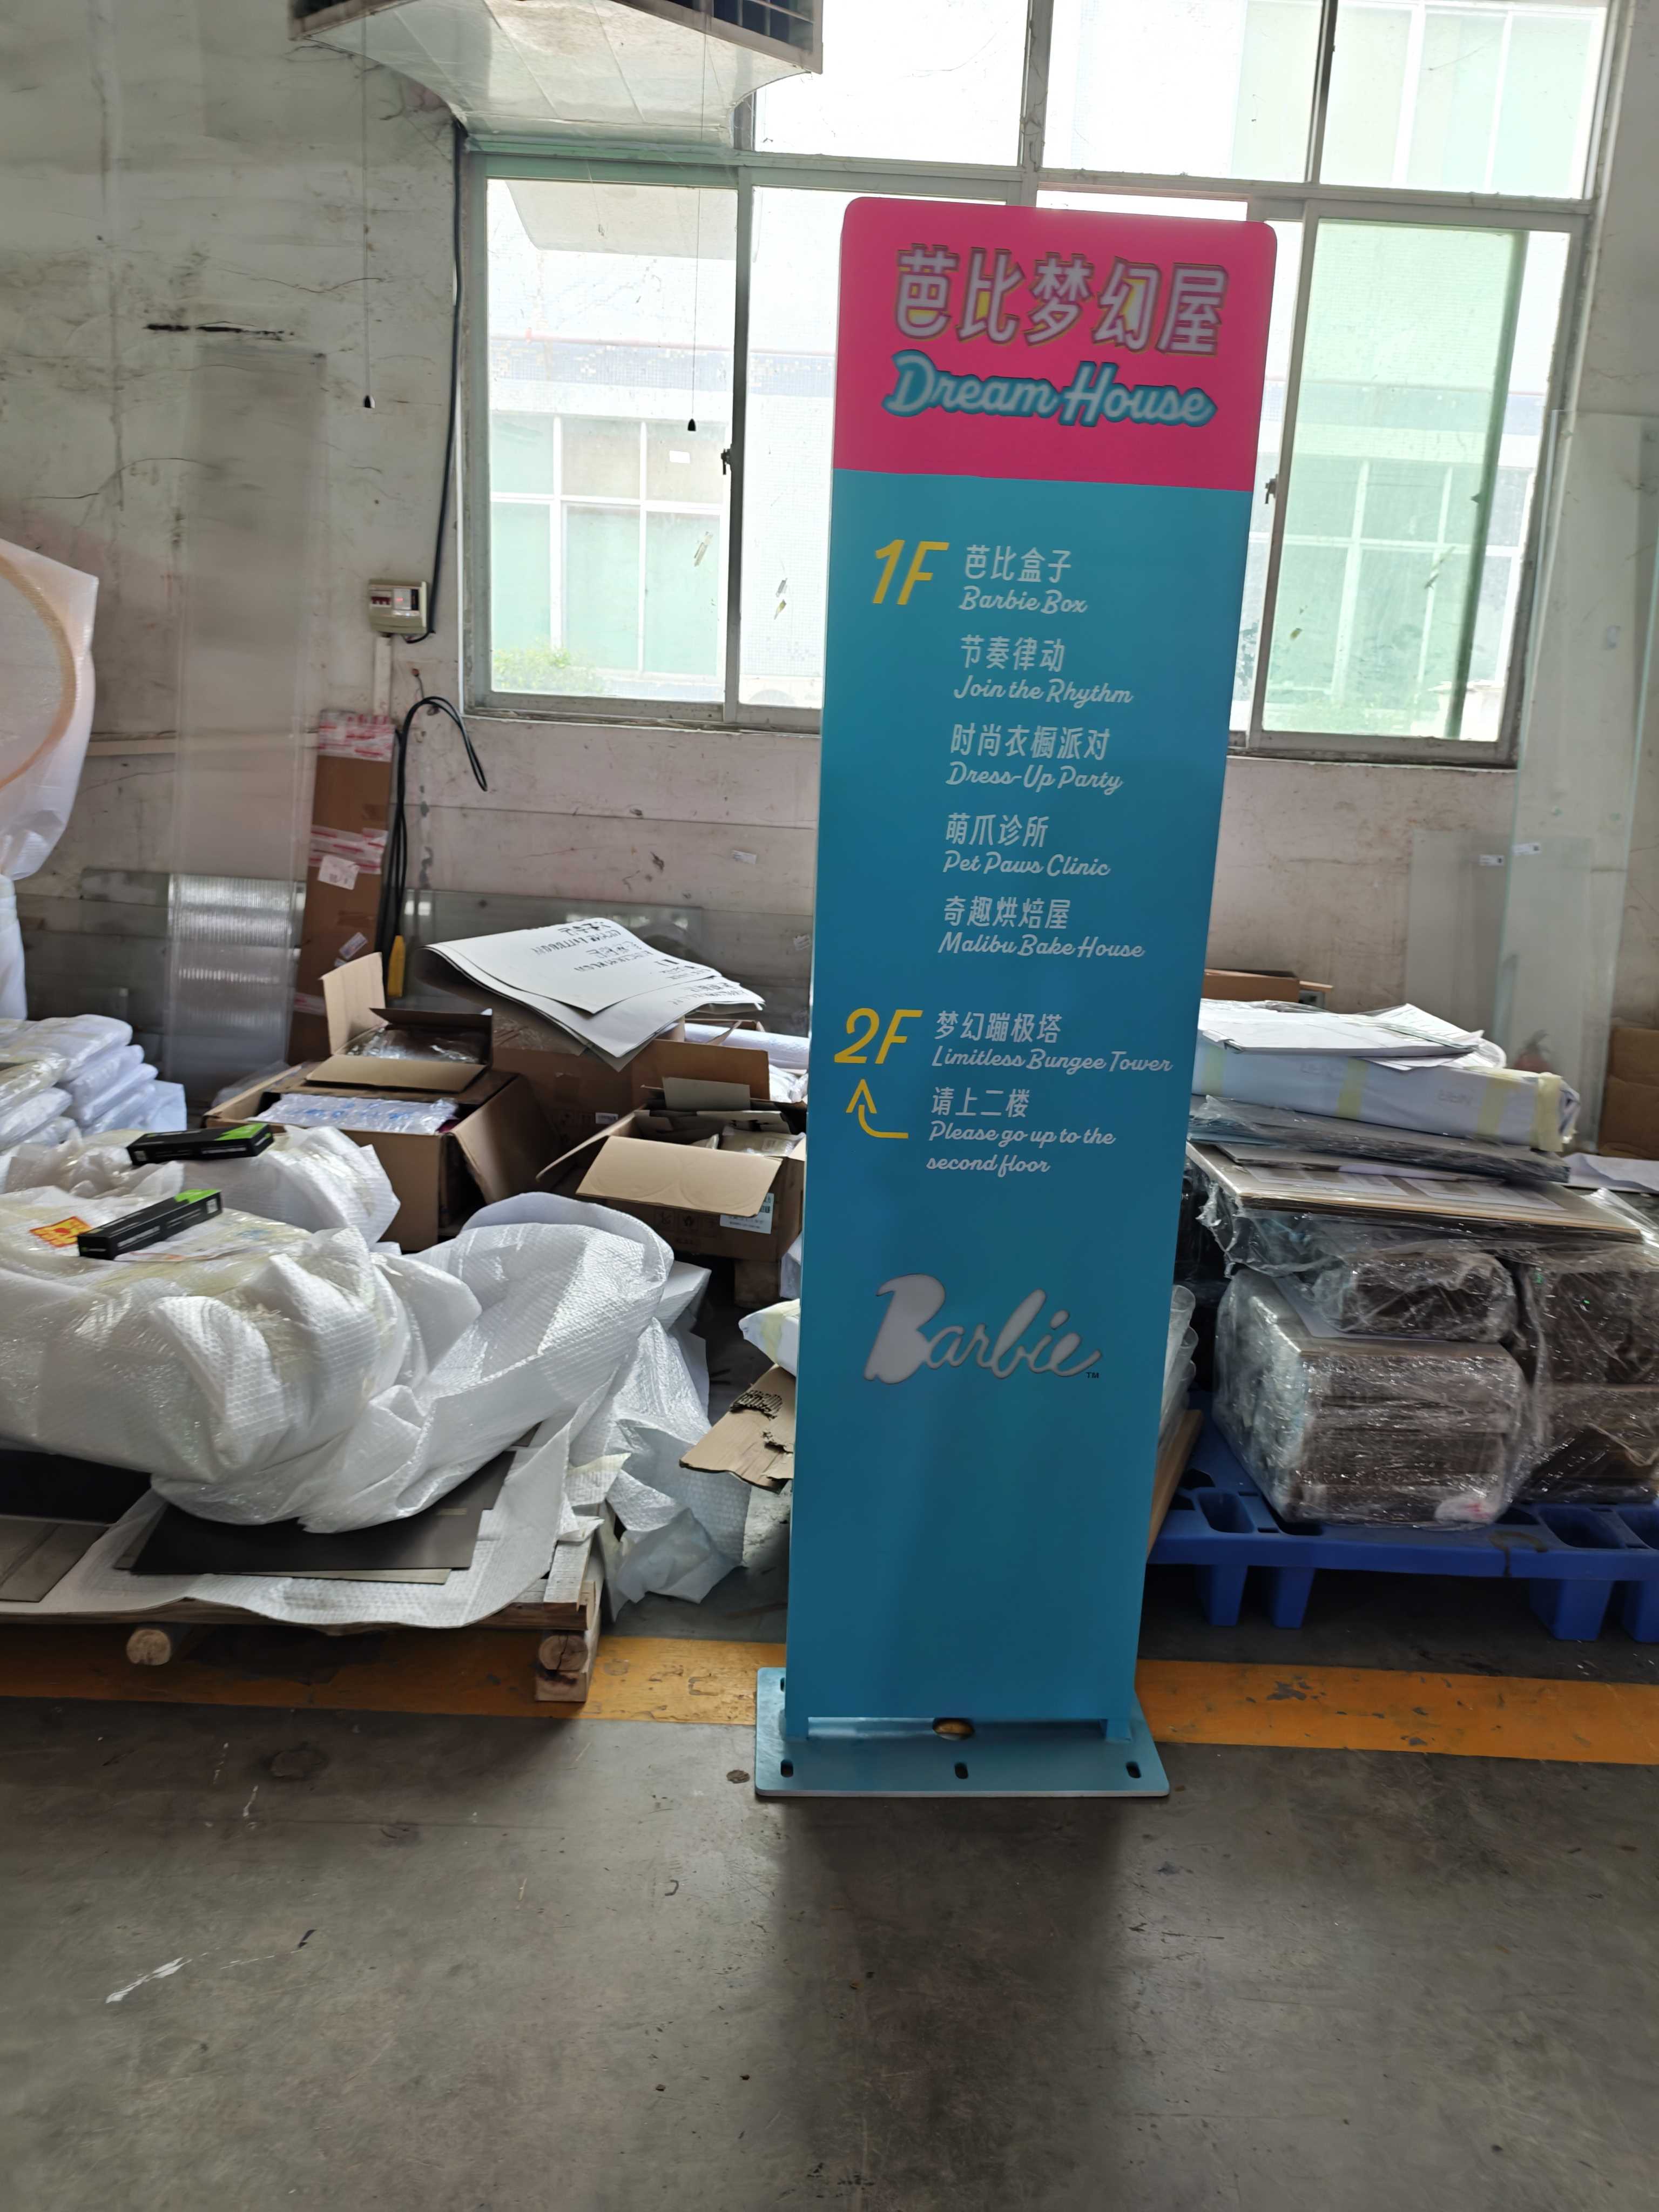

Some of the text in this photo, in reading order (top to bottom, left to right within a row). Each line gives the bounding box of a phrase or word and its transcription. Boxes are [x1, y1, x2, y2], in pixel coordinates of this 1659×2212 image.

[896, 244, 1228, 355] 芭比梦幻屋
[882, 349, 1217, 427] Dream House
[873, 539, 949, 605] 1F
[964, 544, 1072, 583] 芭比盒子
[959, 585, 1088, 615] Barbie Box
[960, 634, 1065, 672] 节奏律动
[954, 676, 1134, 709] Join the Rhythm
[950, 723, 1110, 760] 时尚衣橱派对
[946, 761, 1124, 795] Dress-Up Party
[945, 812, 1049, 848] 萌爪诊所
[943, 850, 1110, 876] Pet Paws Clinic
[943, 896, 1071, 929] 奇趣烘焙屋
[938, 932, 1145, 958] Malibu Bake House
[834, 1008, 923, 1064] 2F
[934, 1010, 1063, 1043] 梦幻蹦极塔
[932, 1046, 1173, 1075] Limitless Bungee Tower
[930, 1087, 1030, 1118] 请上二楼
[929, 1121, 1116, 1148] Please go up to the
[926, 1155, 1050, 1178] second floor
[864, 1273, 1102, 1385] Barbie
